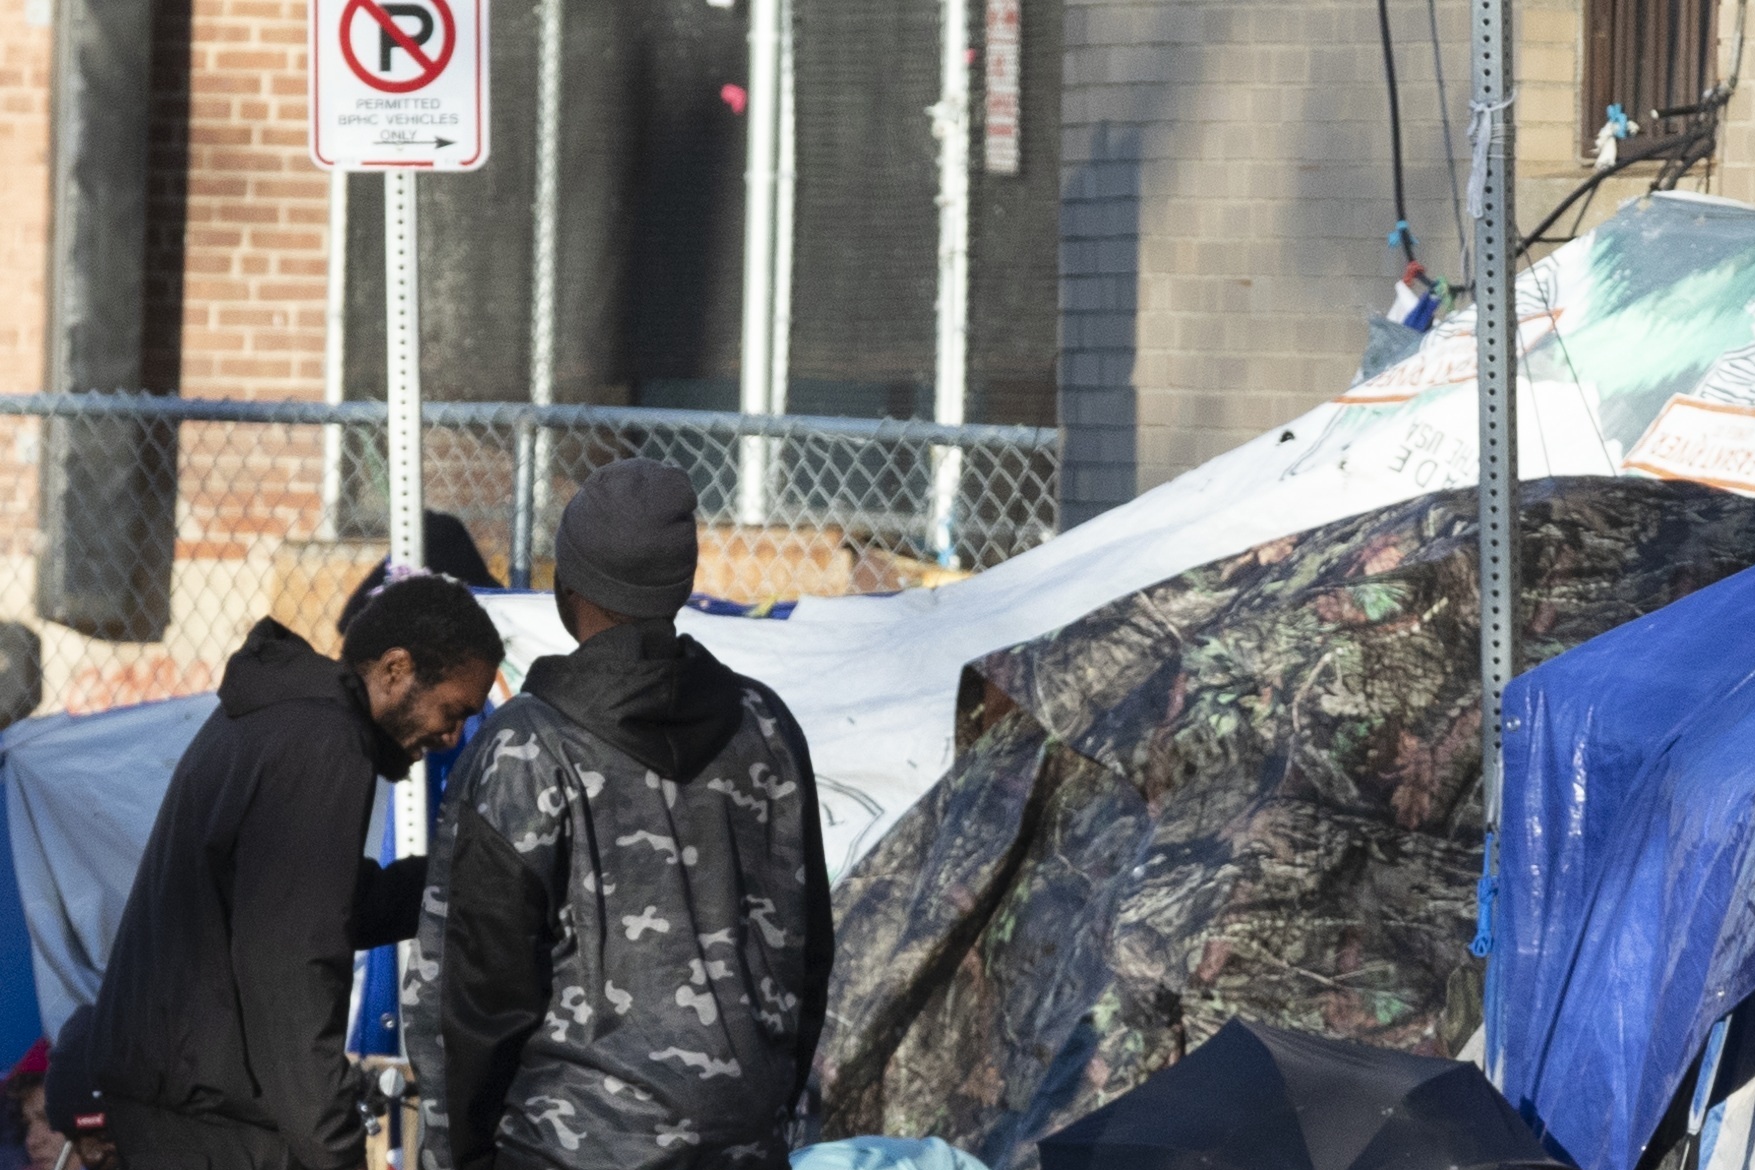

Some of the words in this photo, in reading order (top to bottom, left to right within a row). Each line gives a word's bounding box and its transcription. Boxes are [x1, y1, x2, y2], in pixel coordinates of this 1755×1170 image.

[356, 98, 440, 110] PERMITTED
[338, 114, 379, 126] BPHC
[386, 113, 459, 126] VEHICLES
[380, 129, 418, 141] ONLY
